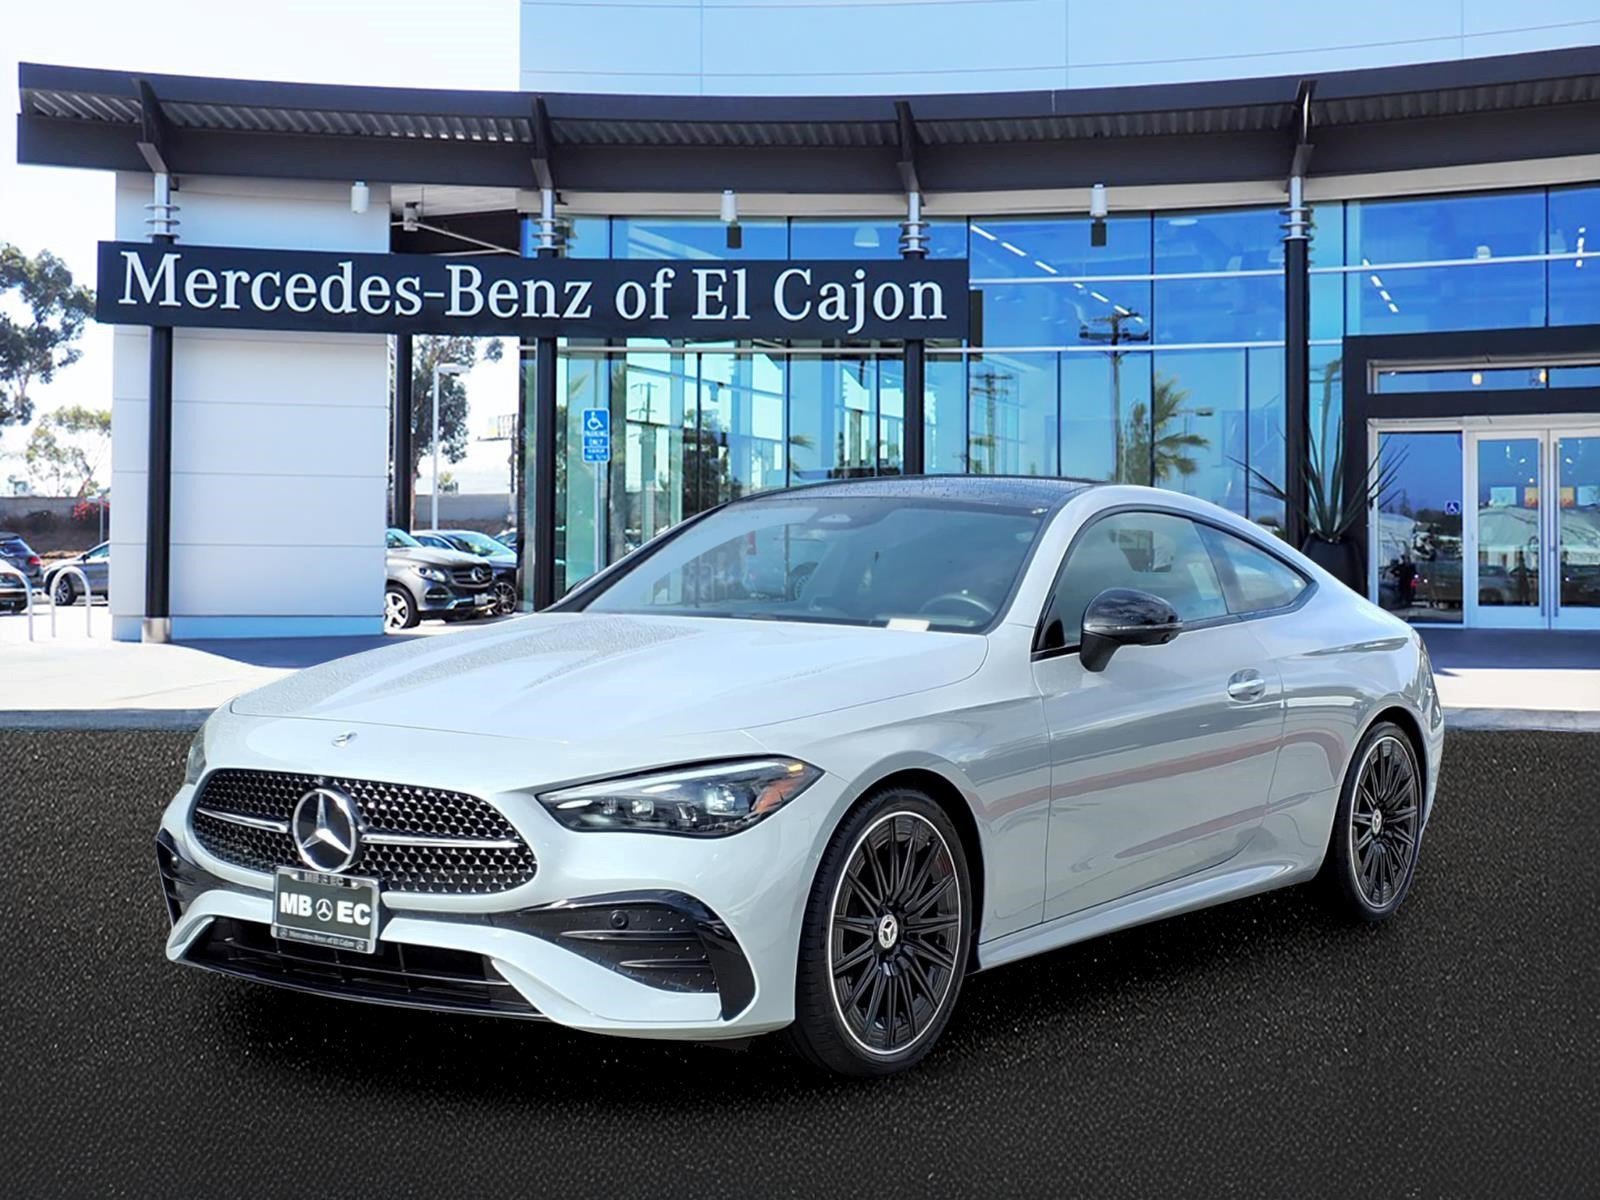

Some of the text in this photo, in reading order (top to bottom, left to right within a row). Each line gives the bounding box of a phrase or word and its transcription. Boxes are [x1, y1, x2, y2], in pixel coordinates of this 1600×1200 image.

[118, 251, 948, 335] Mercedes-Benz of El Cajon
[280, 891, 371, 926] MB EC
